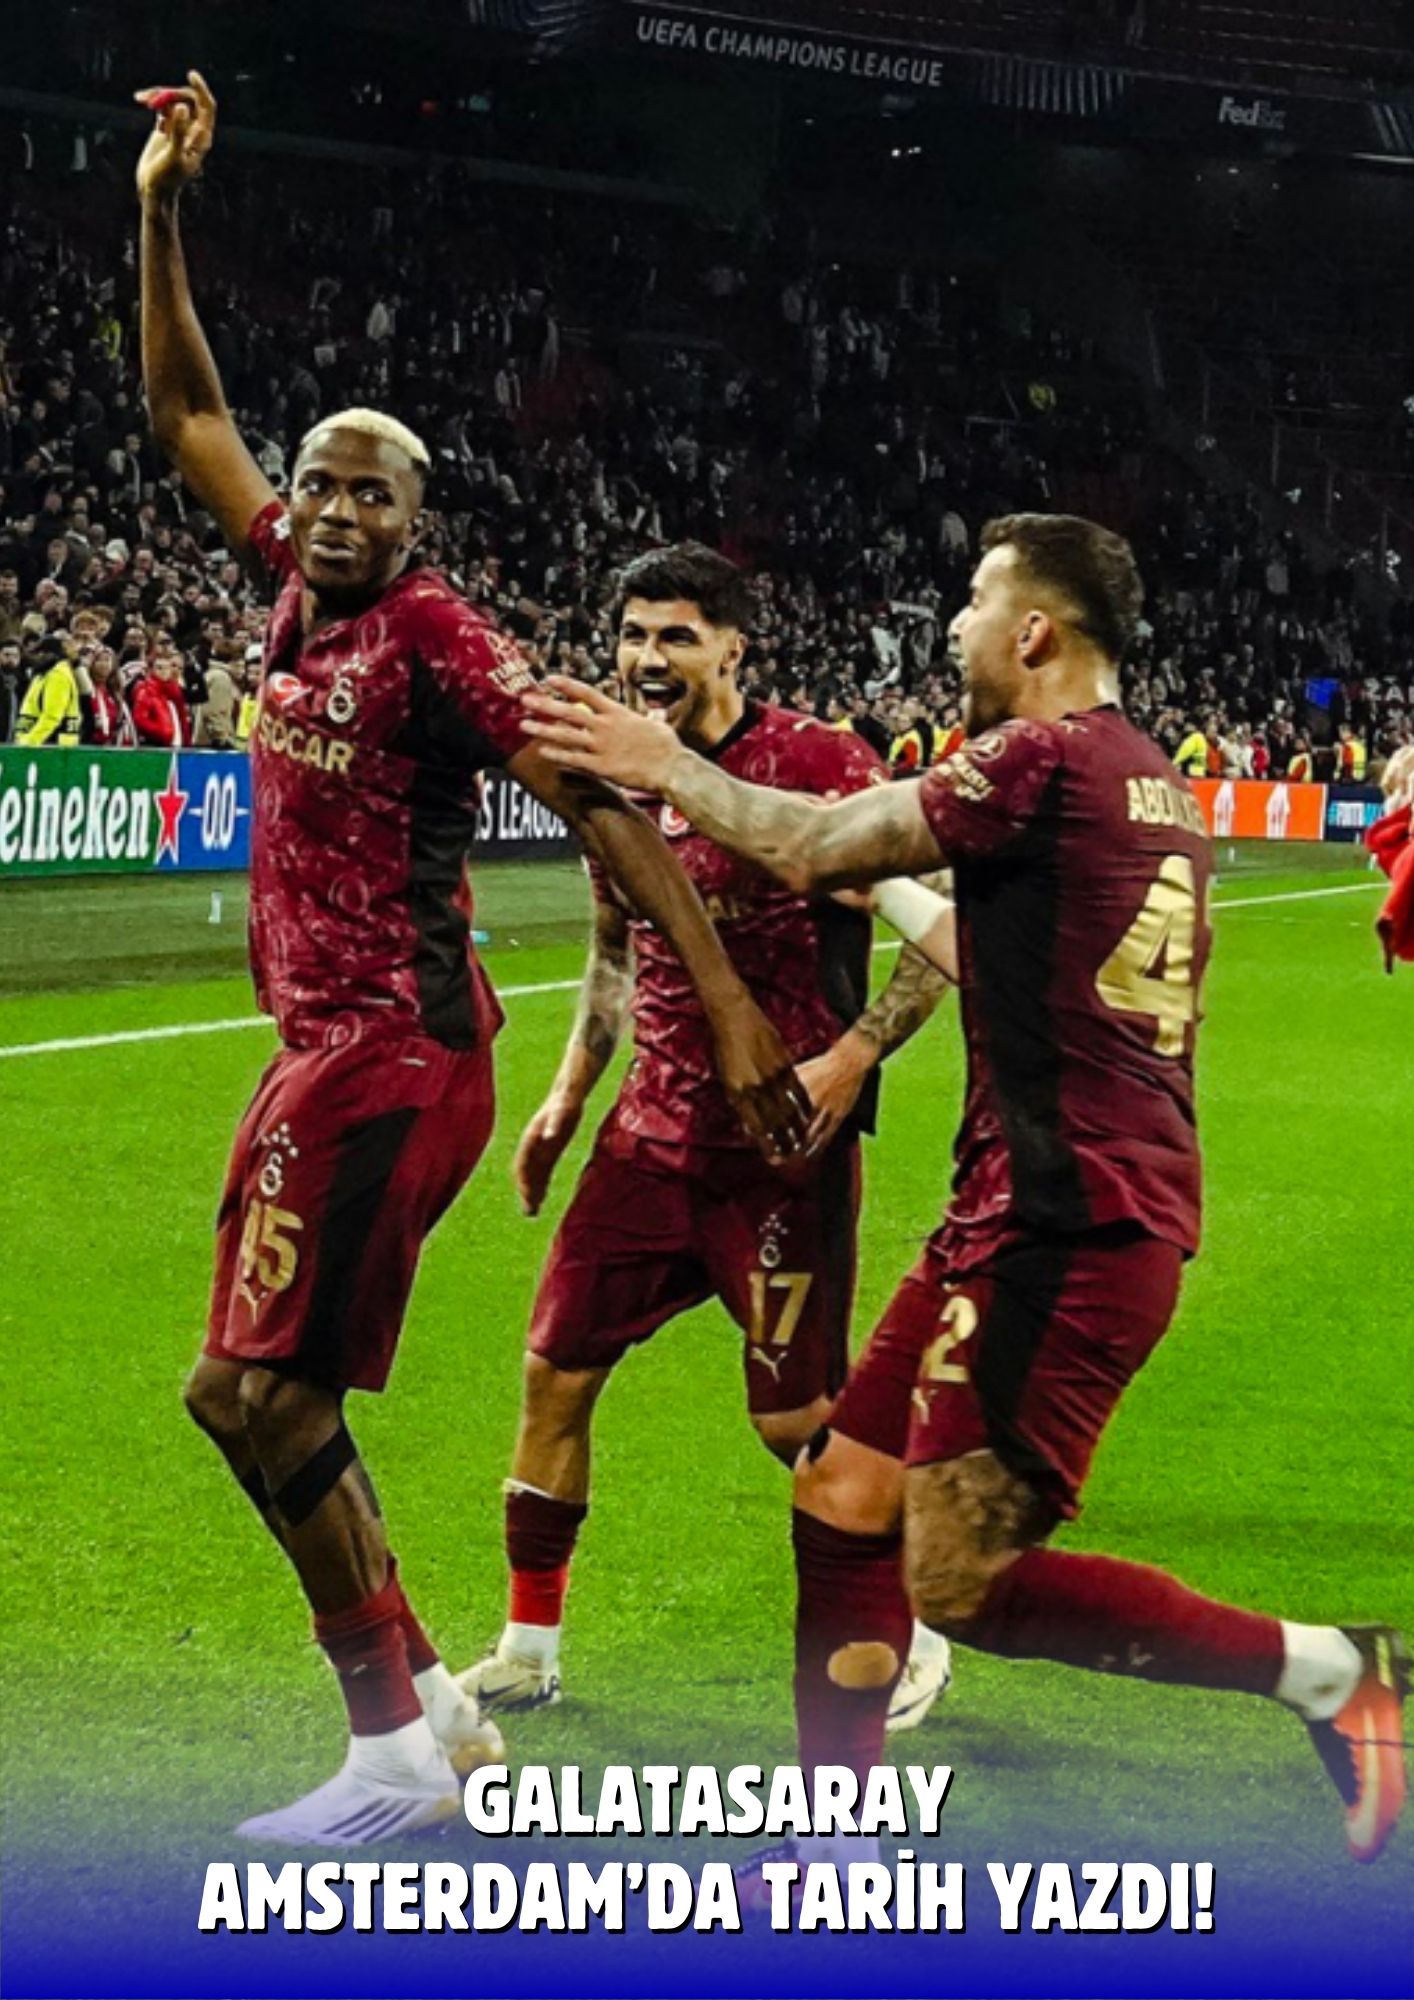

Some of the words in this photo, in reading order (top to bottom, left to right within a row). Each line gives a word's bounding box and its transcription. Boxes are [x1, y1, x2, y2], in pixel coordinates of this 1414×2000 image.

[636, 16, 698, 48] UEFA
[705, 27, 846, 71] CHAMPIONS
[850, 50, 943, 86] LEAGUE
[257, 712, 355, 774] SOCAR
[0, 761, 150, 863] eineken
[749, 1272, 812, 1346] 17
